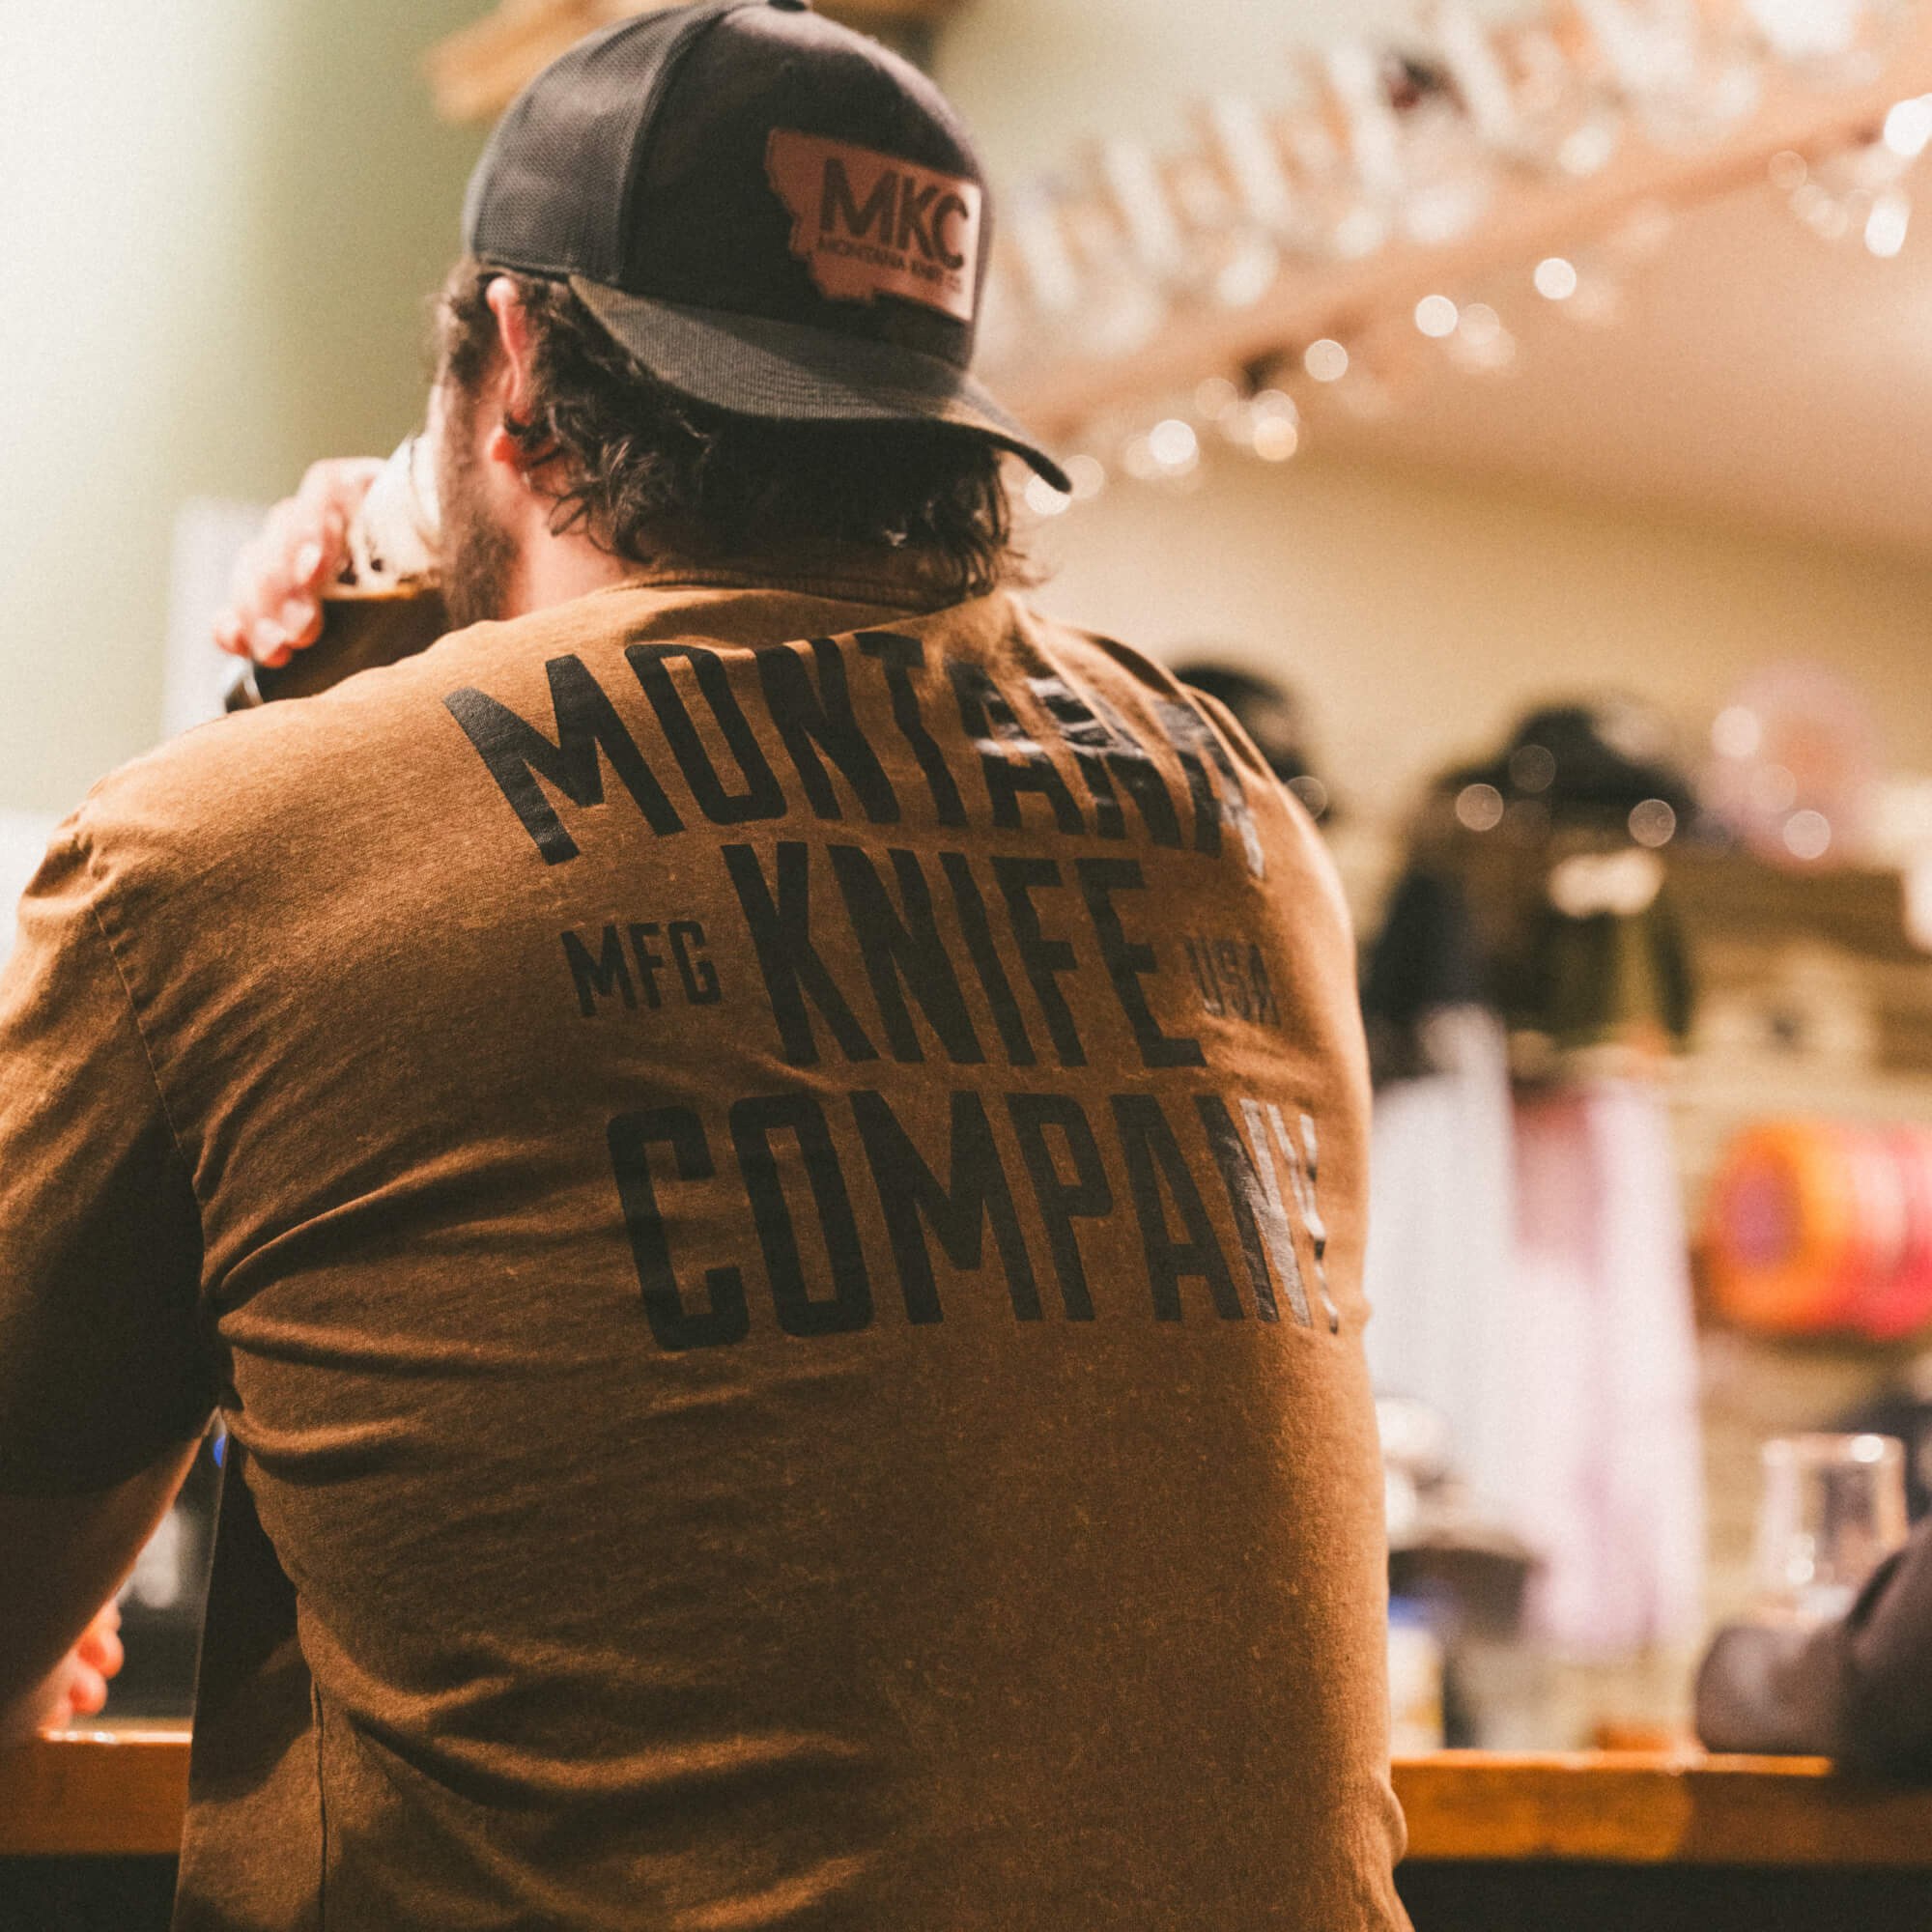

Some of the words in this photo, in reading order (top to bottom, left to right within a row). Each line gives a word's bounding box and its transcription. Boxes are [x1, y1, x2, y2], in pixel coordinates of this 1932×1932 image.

[821, 157, 969, 270] MKC
[560, 921, 722, 1017] MFG
[721, 841, 1208, 1068] KNIFE
[1183, 934, 1282, 1029] USA
